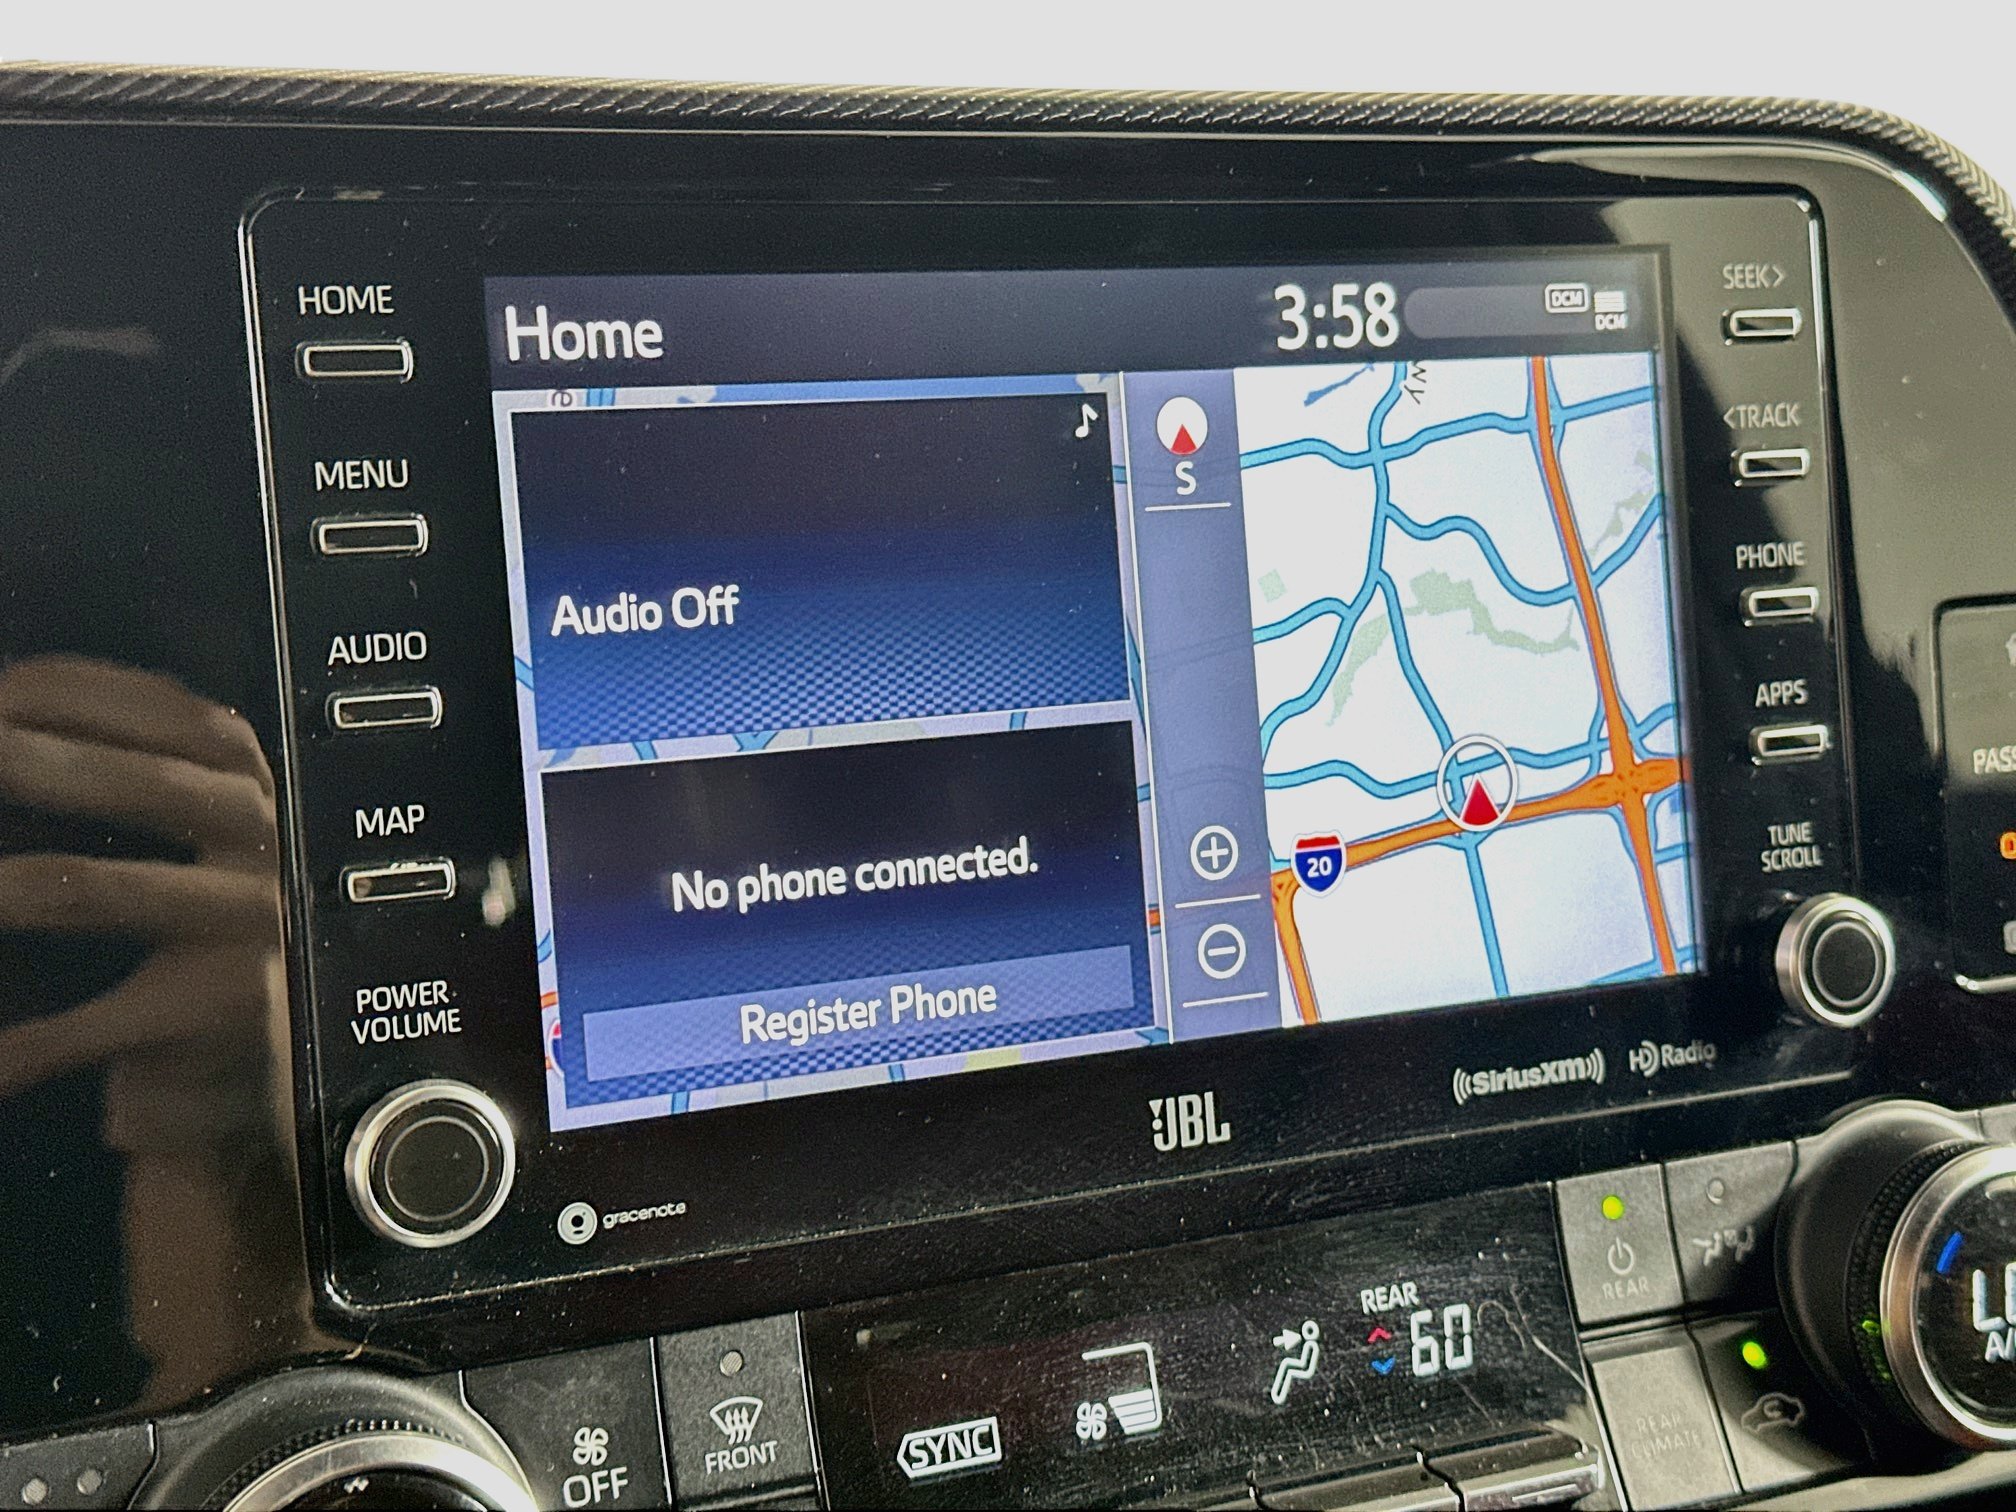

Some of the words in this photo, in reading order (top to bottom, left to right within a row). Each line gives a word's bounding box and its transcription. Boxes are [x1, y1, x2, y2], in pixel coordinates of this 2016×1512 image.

[298, 284, 395, 316] HOME
[1551, 290, 1584, 308] DCM
[504, 304, 665, 363] Home
[1273, 282, 1400, 352] 3:58
[1595, 313, 1628, 331] DCM
[315, 459, 410, 491] MENU
[1174, 461, 1198, 496] S
[1736, 541, 1806, 569] PHONE
[550, 592, 664, 637] Audio
[670, 584, 740, 627] Off
[327, 630, 428, 667] AUDIO
[1755, 678, 1809, 708] APPS
[355, 804, 426, 838] MAP
[1766, 822, 1813, 847] TUNE
[671, 869, 730, 913] No
[737, 862, 848, 914] phone
[854, 834, 1039, 893] connected.
[1306, 857, 1333, 879] 20
[1760, 845, 1824, 874] SCROLL
[355, 980, 450, 1014] POWER
[350, 1008, 463, 1045] VOLUME
[740, 997, 883, 1046] Register
[890, 983, 998, 1025] Phone
[1661, 1040, 1717, 1068] Radio
[1154, 1090, 1232, 1152] JBL
[602, 1202, 687, 1229] gracenote
[1360, 1281, 1420, 1315] REAR
[1601, 1275, 1652, 1299] REAR
[1410, 1302, 1474, 1379] 60
[704, 1440, 778, 1474] FRONT
[907, 1428, 995, 1468] SYNC
[562, 1466, 629, 1508] OFF
